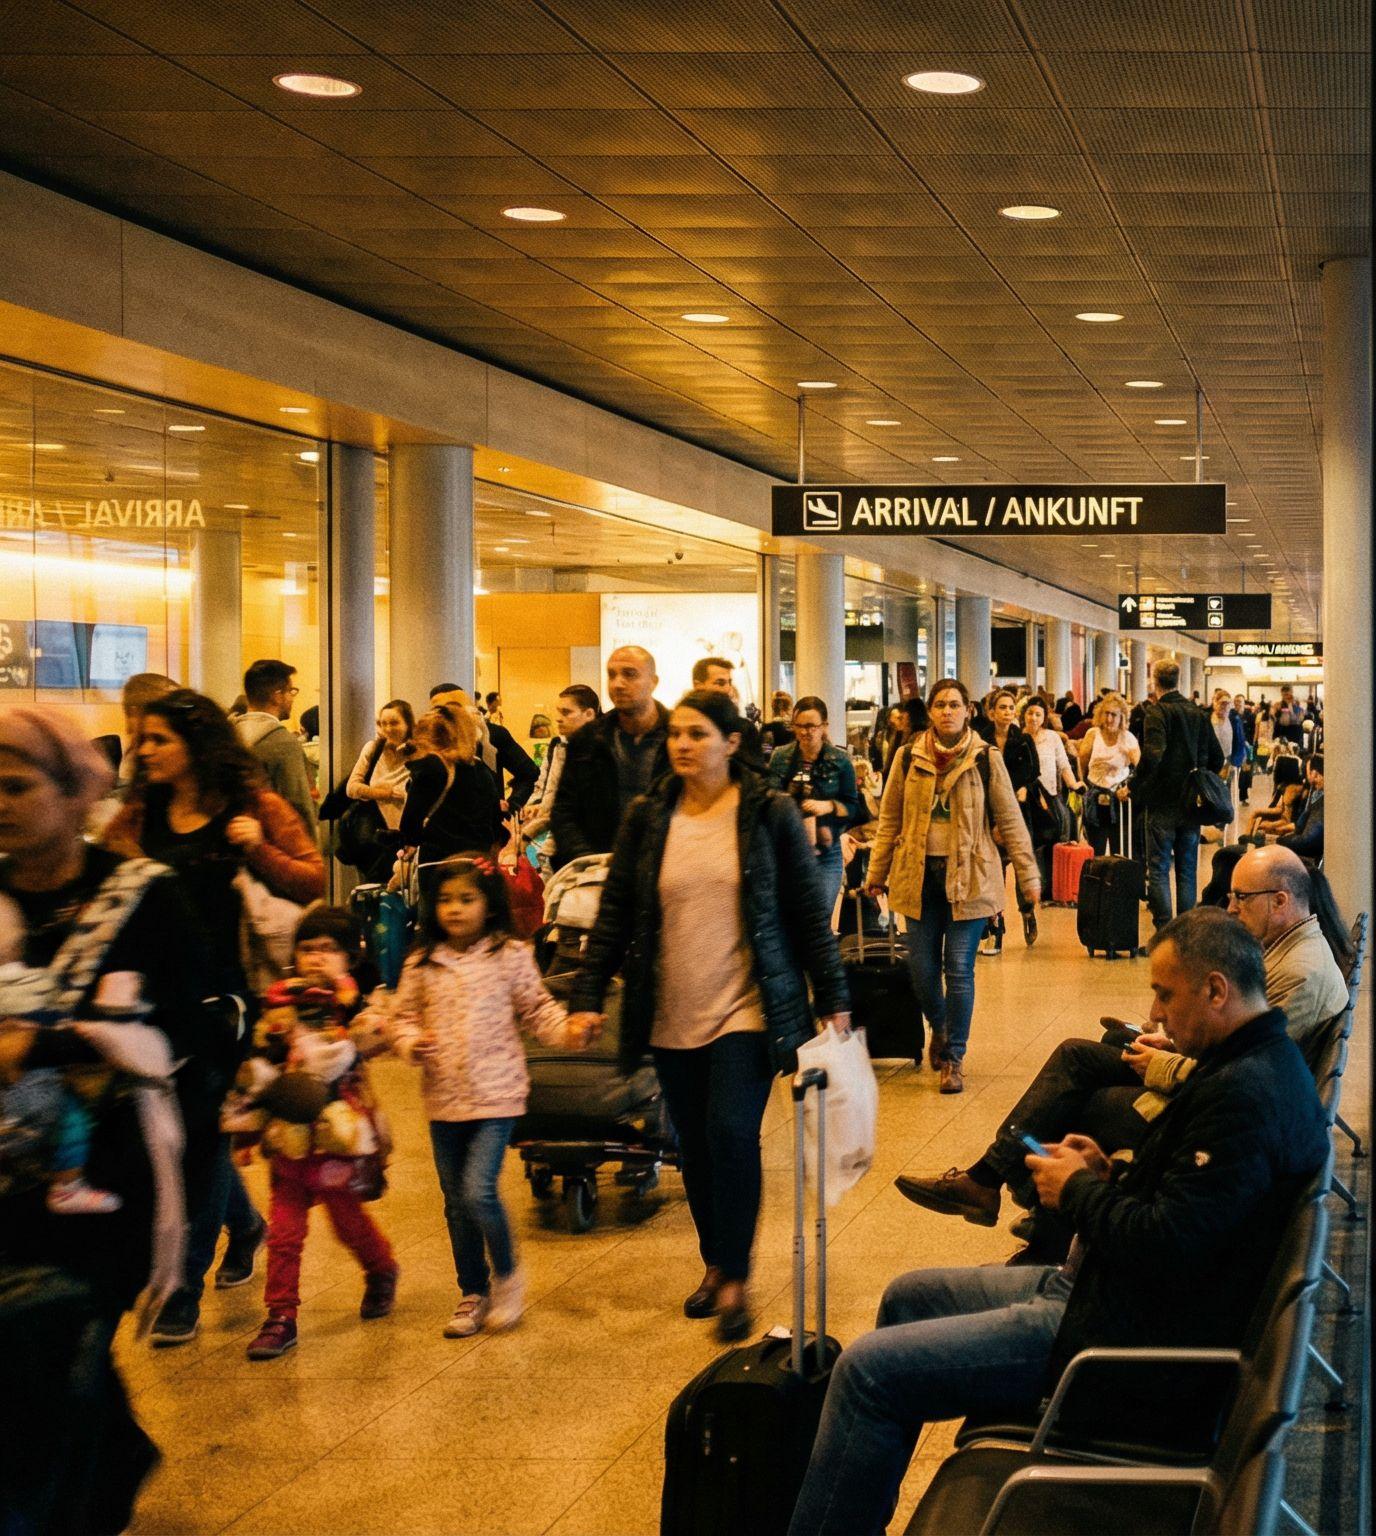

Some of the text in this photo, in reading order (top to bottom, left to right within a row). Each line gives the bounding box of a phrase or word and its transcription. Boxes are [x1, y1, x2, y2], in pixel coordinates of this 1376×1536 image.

[851, 496, 1144, 527] ARRIVAL / ANKUNFT
